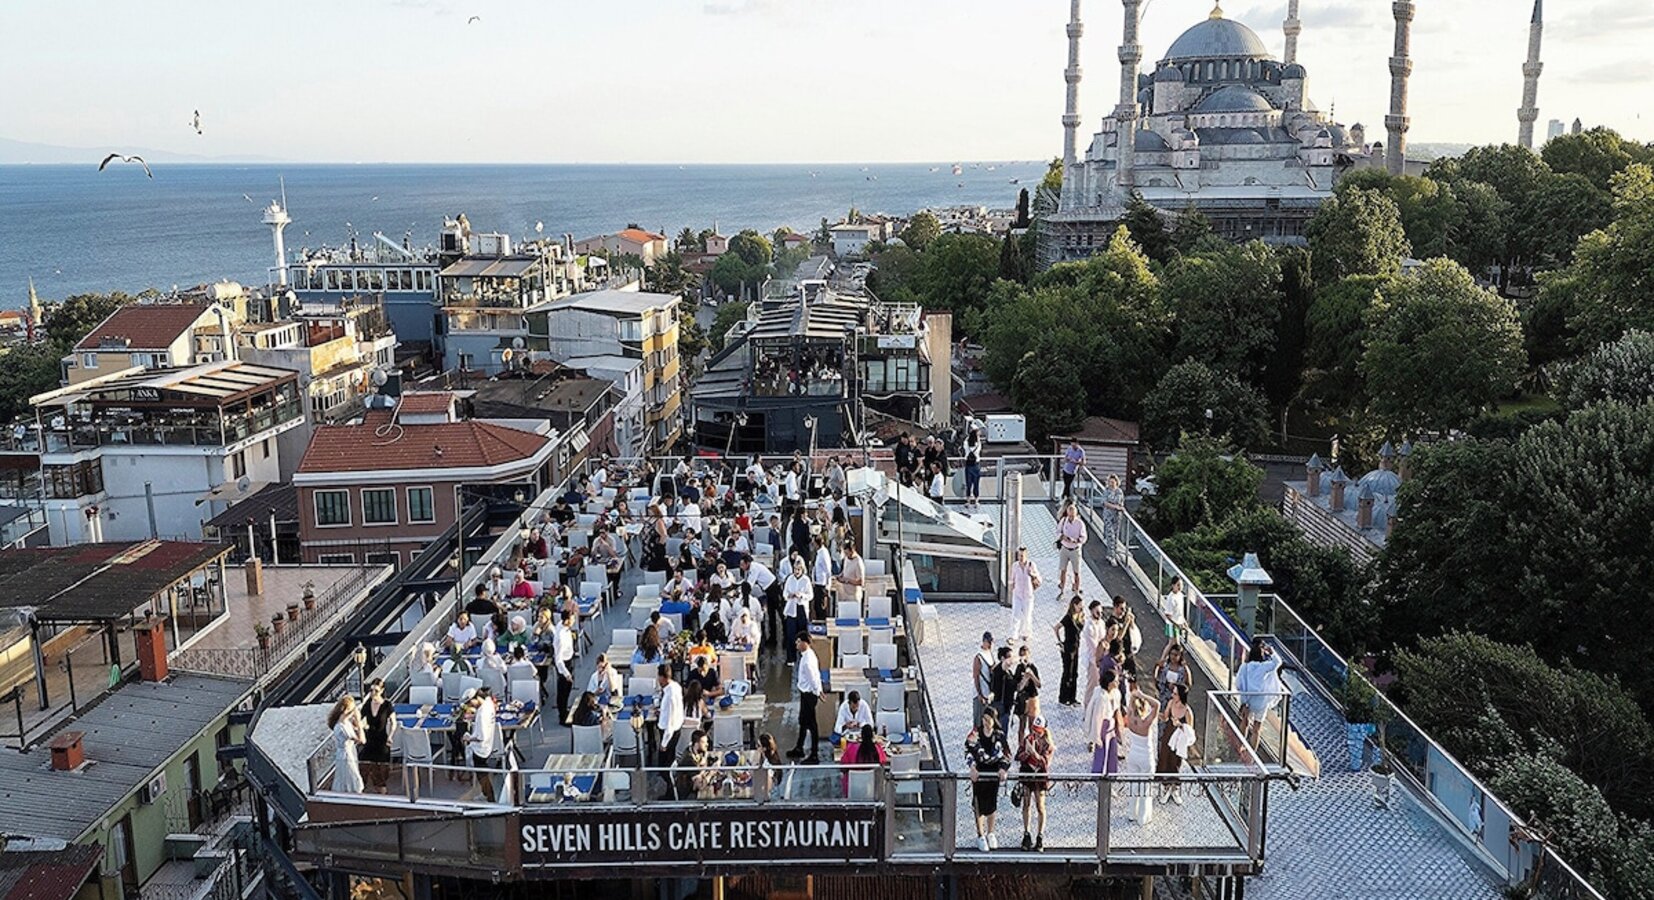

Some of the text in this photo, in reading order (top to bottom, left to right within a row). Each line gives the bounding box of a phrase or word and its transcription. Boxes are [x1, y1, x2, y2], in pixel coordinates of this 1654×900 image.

[522, 820, 874, 852] SEVEN HILLS CAFE RESTAURANT
